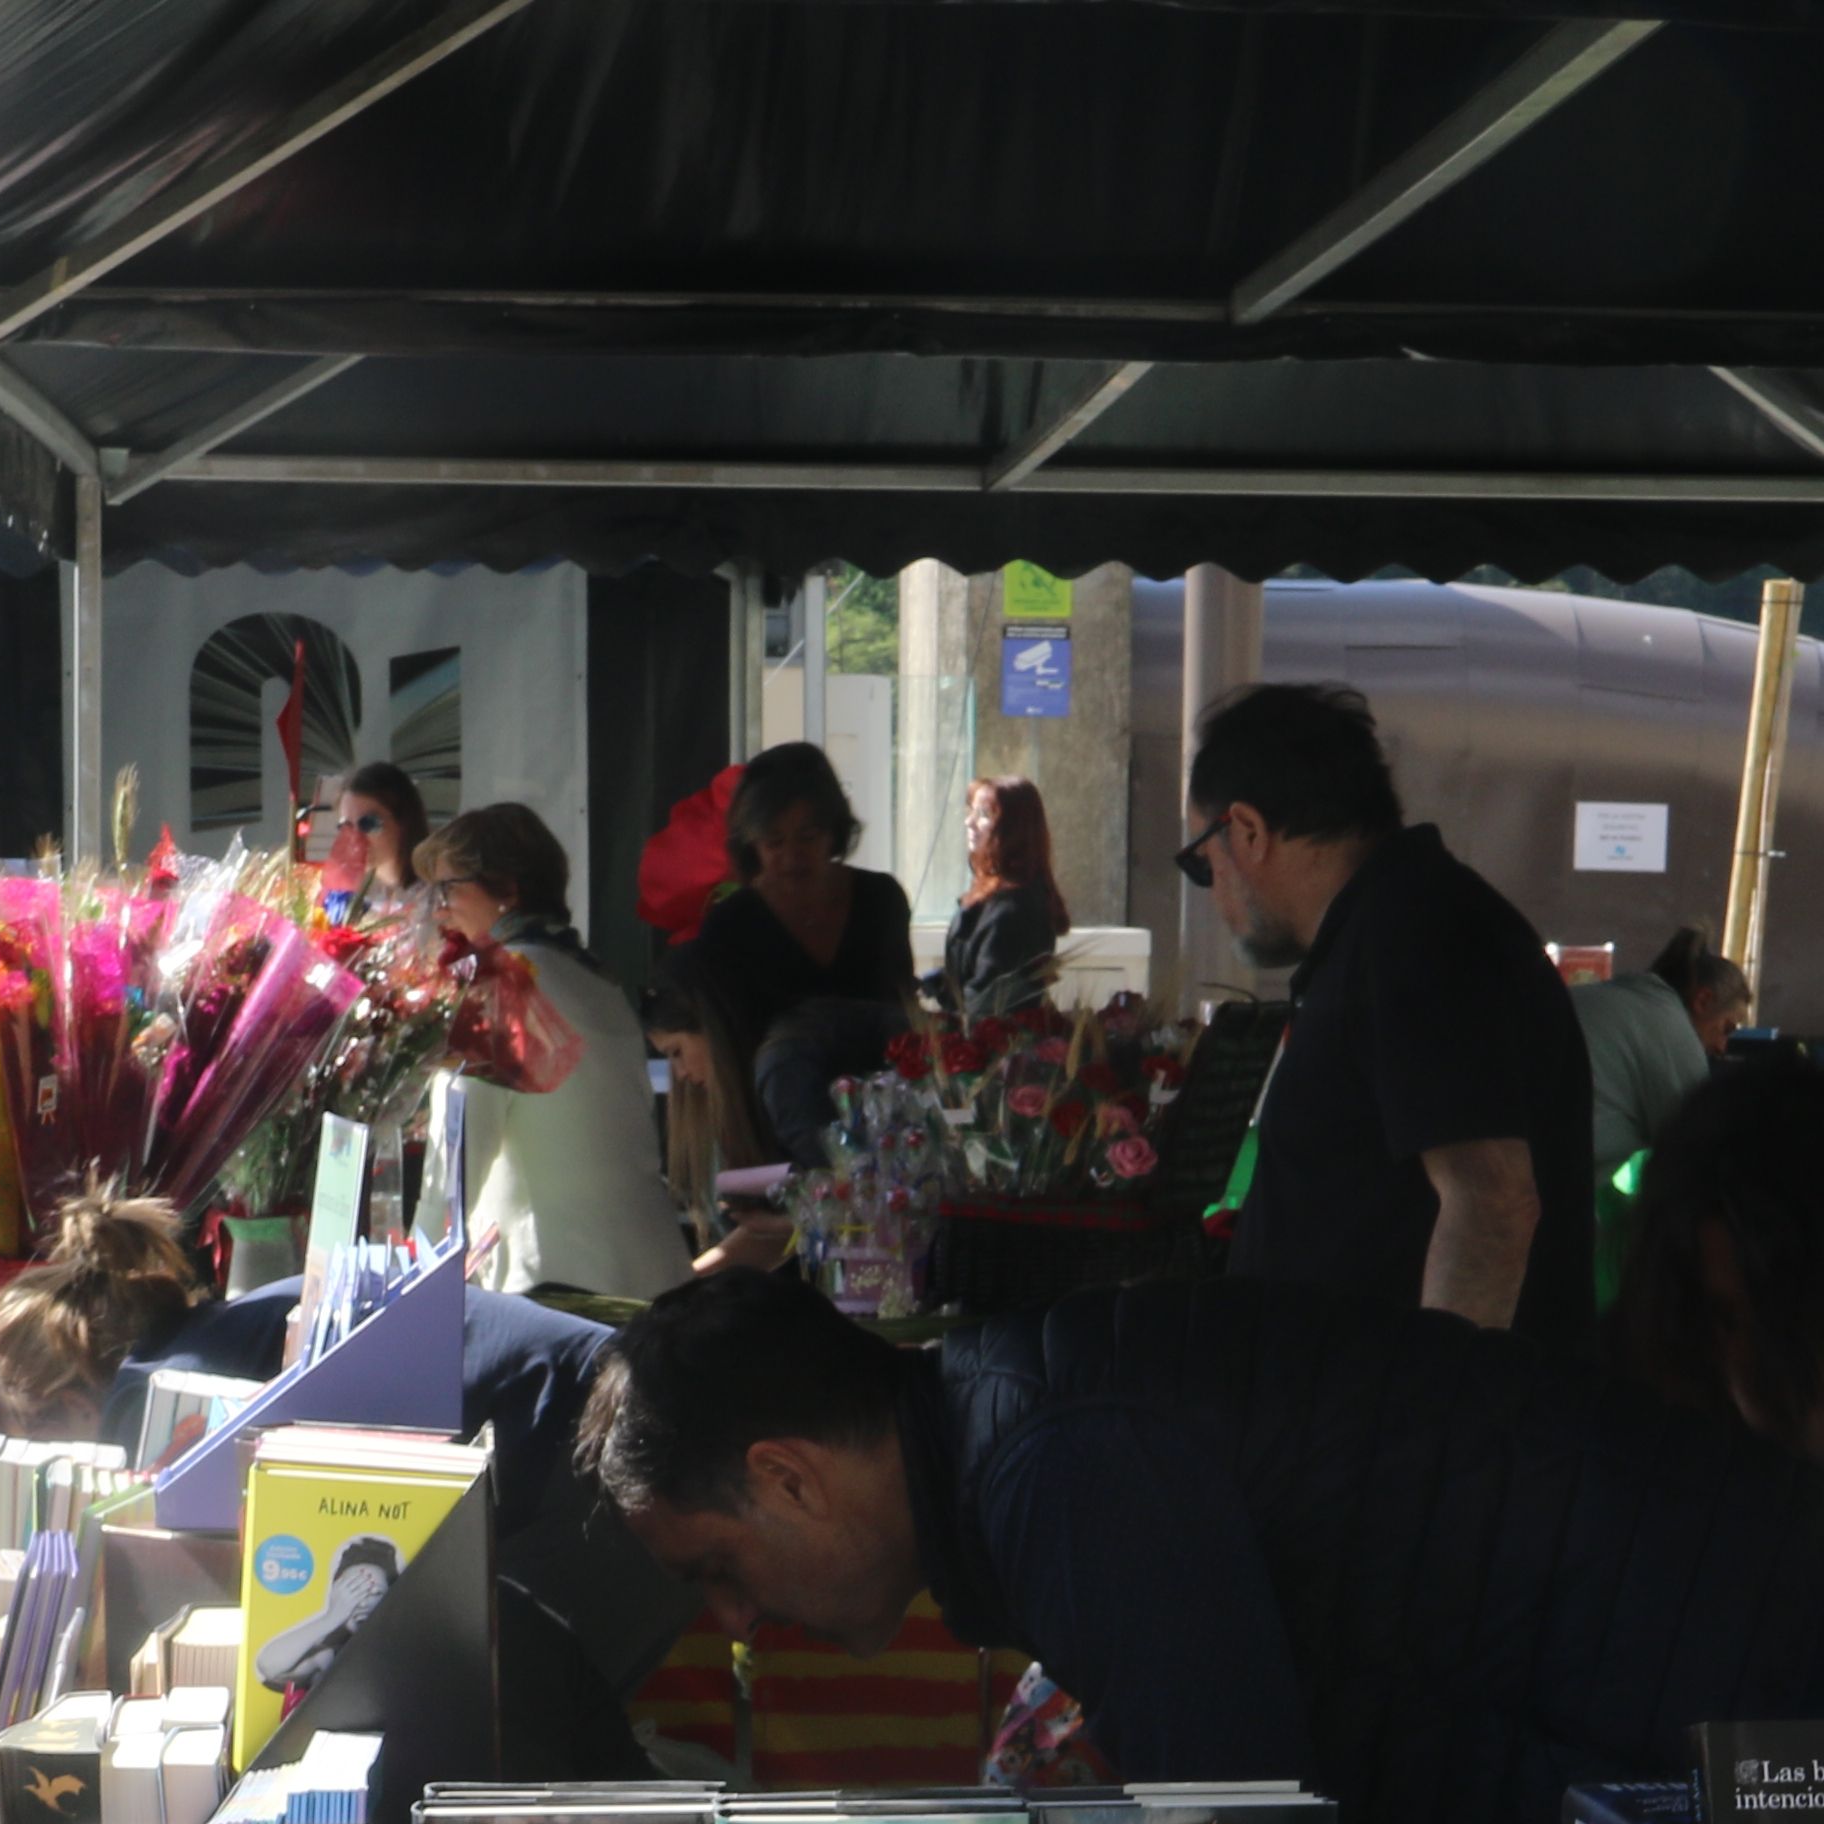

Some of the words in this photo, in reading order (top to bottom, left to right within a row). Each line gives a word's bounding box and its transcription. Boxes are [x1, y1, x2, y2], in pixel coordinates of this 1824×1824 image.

[318, 1498, 369, 1517] ALINA
[378, 1501, 412, 1520] NOT
[1762, 1760, 1805, 1783] Las
